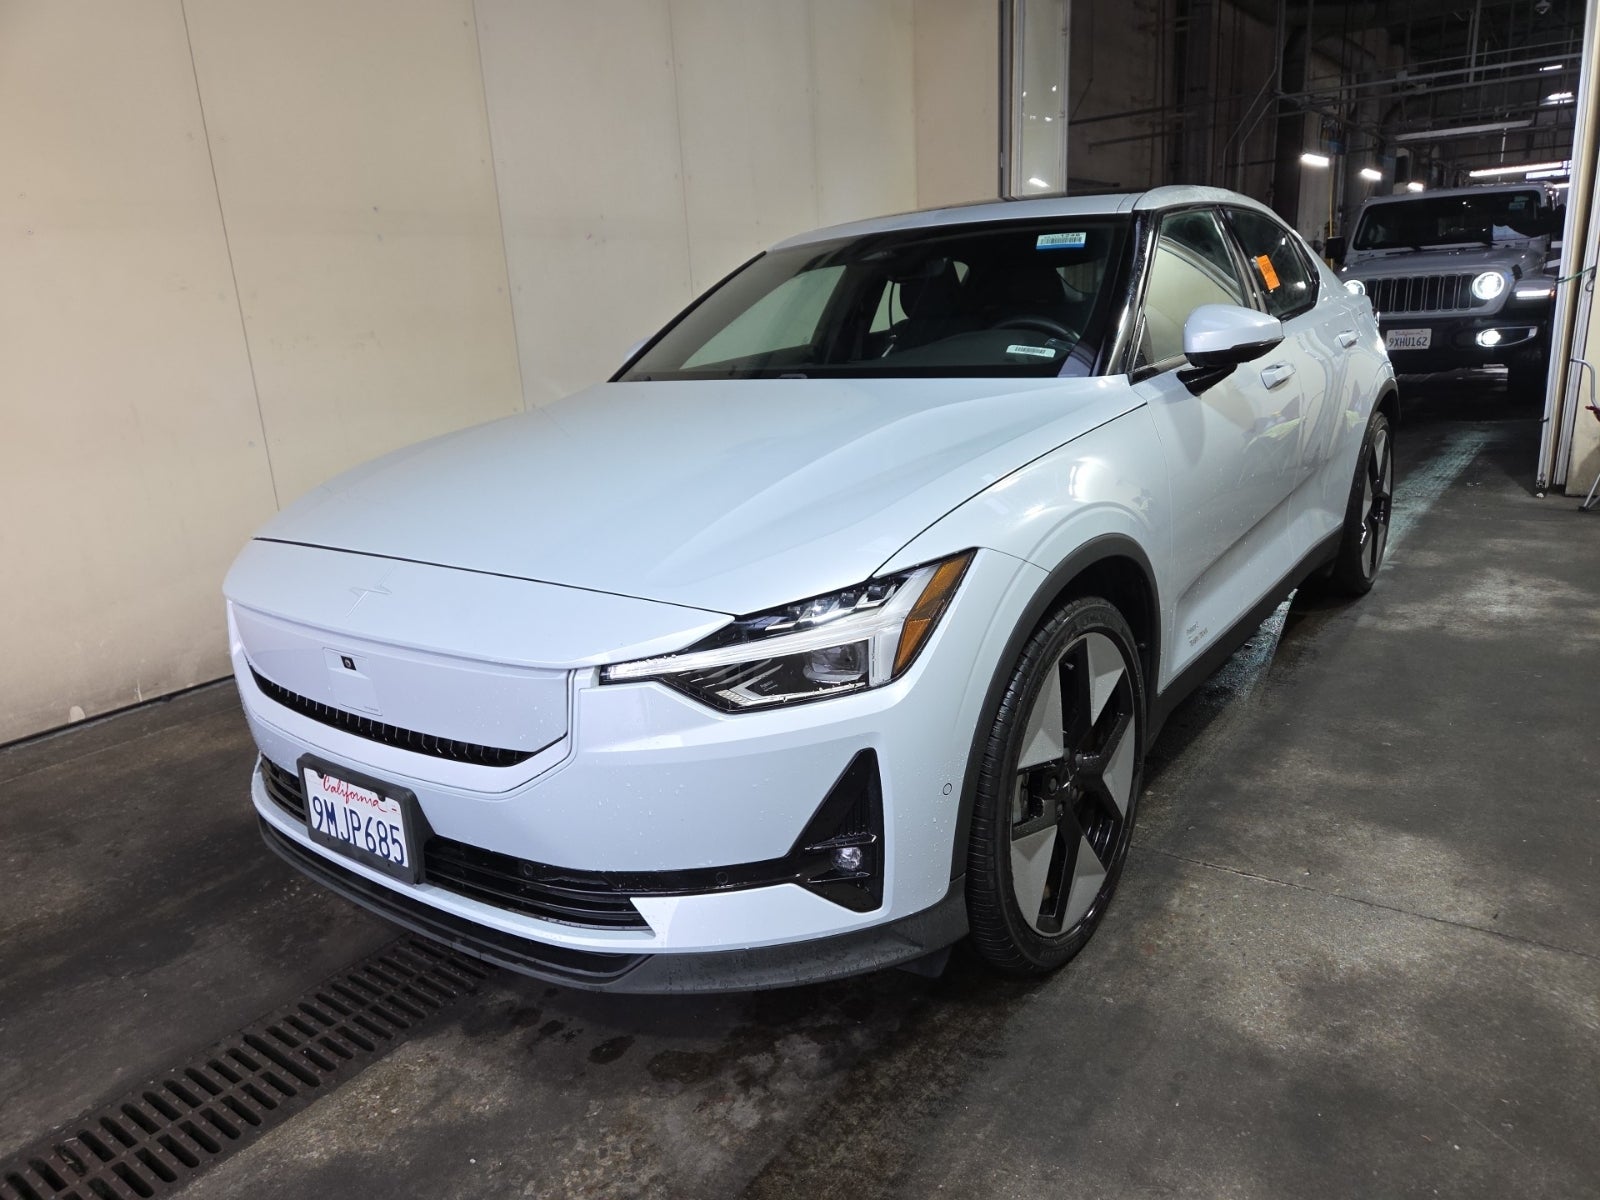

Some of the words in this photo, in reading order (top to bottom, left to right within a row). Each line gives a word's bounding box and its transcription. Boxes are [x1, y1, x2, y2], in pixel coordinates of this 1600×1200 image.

[1389, 336, 1428, 347] 9XHU162
[323, 774, 387, 812] California
[313, 796, 405, 865] 9MJP685
